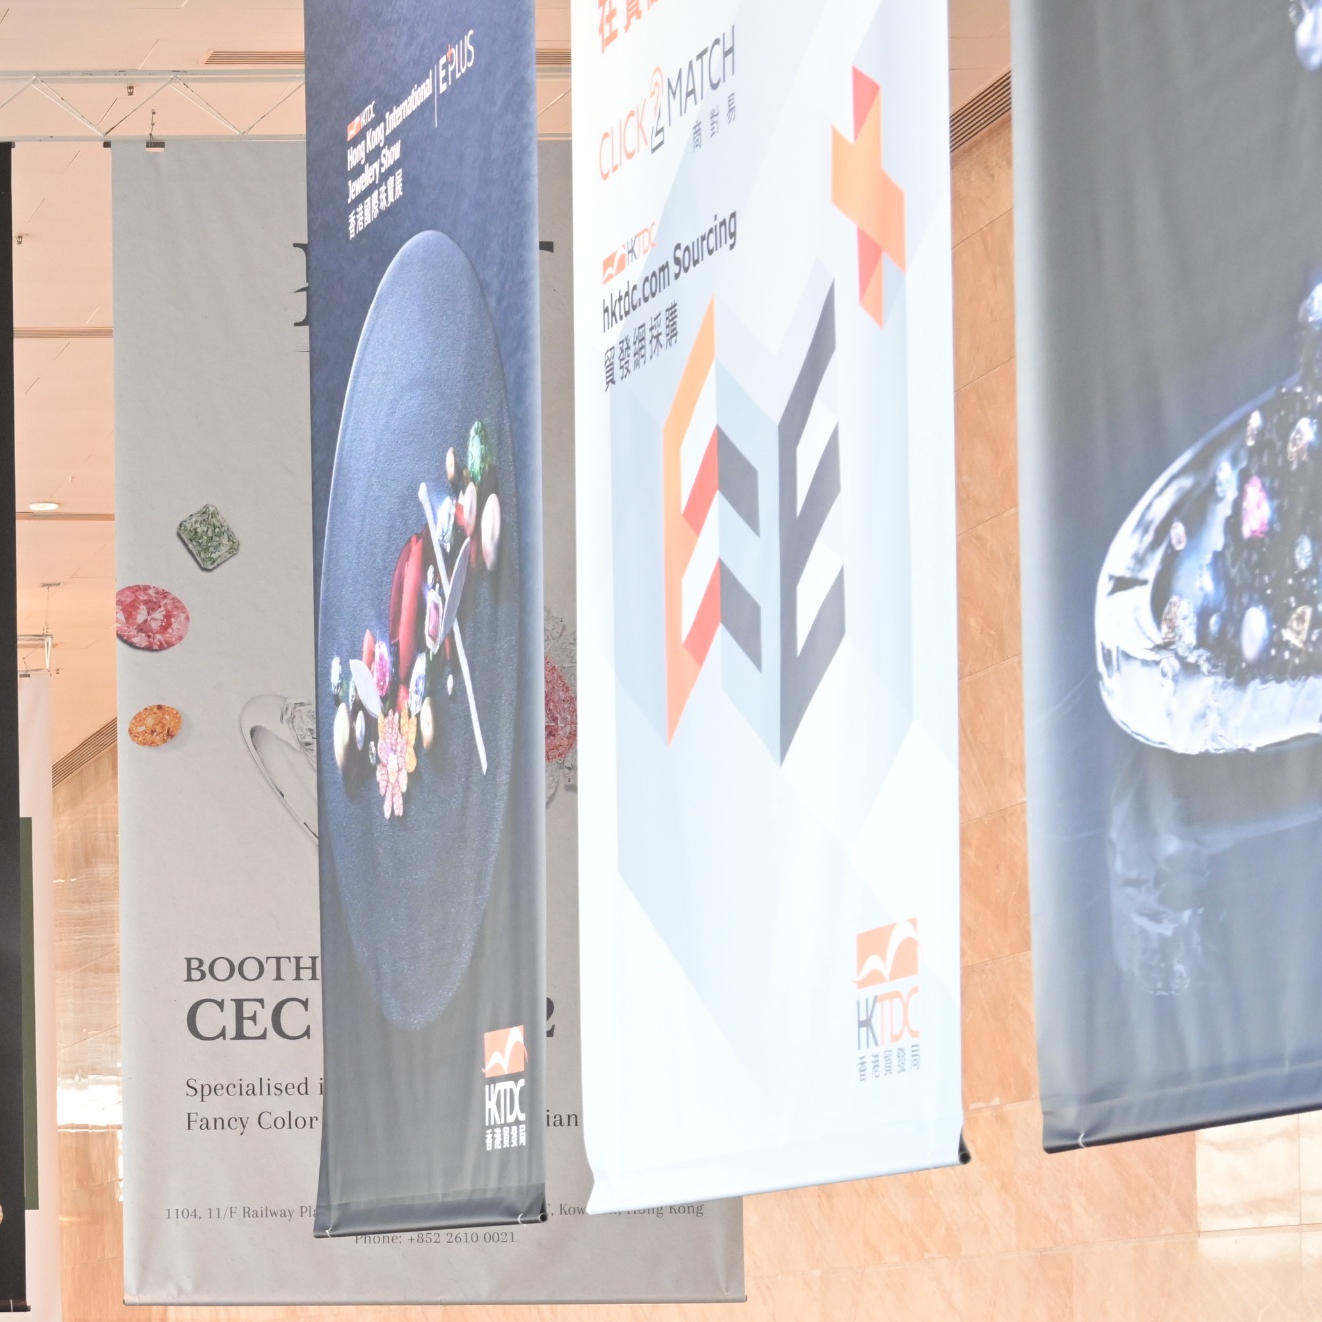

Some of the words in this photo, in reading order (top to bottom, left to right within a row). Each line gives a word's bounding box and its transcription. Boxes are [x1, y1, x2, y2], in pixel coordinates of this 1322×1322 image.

[347, 140, 365, 171] Hong
[367, 121, 384, 153] Kong
[386, 70, 432, 136] International
[347, 159, 379, 203] Jewellery
[381, 140, 401, 173] Show
[348, 169, 403, 240] 香港國際珠寶展
[627, 220, 656, 266] HKTDC
[603, 261, 670, 333] hktdc.com
[674, 210, 738, 280] Sourcing
[604, 300, 679, 391] 貿發網採購
[183, 955, 320, 983] BOOTH
[186, 997, 311, 1042] CEC
[857, 985, 920, 1051] HKTDC
[185, 1076, 310, 1101] Specialised
[485, 1078, 526, 1127] HKTDC
[186, 1112, 250, 1136] Fancy
[257, 1110, 319, 1130] Color
